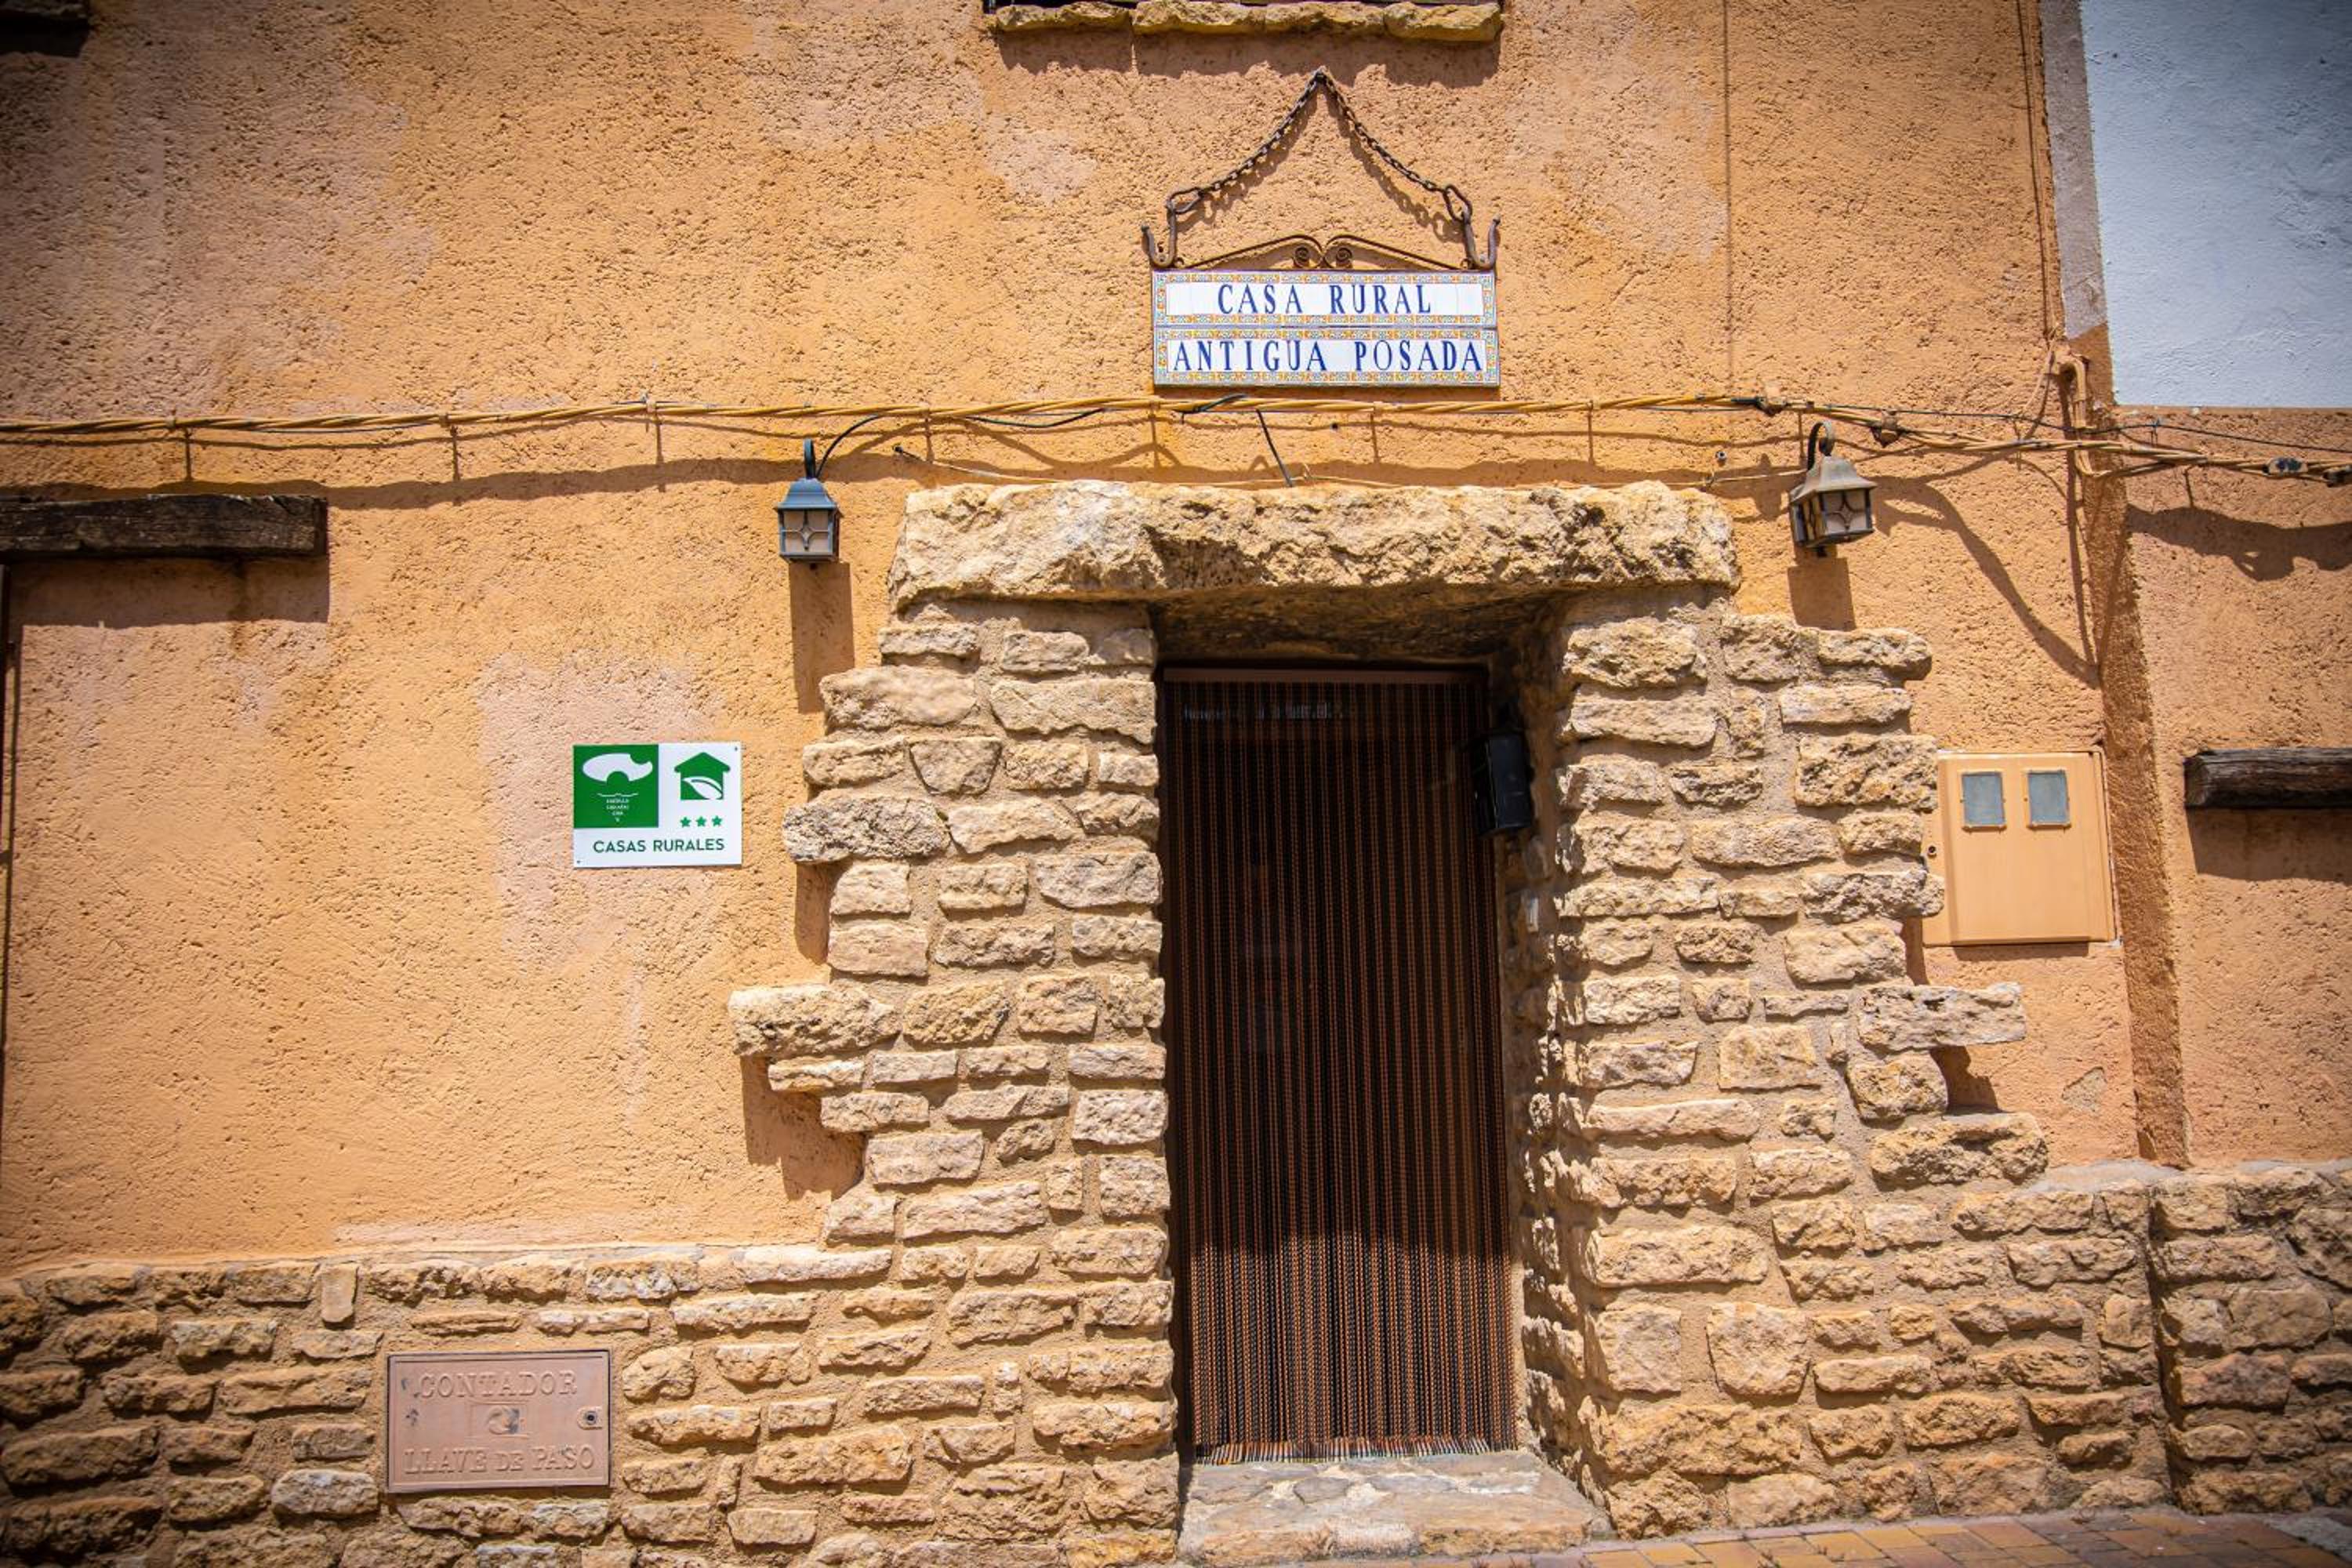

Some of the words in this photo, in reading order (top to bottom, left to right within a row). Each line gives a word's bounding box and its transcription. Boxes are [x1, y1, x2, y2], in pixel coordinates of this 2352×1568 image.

[1218, 284, 1303, 314] CASA
[1330, 285, 1432, 314] RURAL
[1174, 339, 1327, 372] ANTIGUA
[1356, 339, 1482, 372] POSADA
[593, 840, 646, 853] CASAS
[653, 839, 724, 852] RURALES
[419, 1370, 577, 1399] CONTADOR
[404, 1449, 488, 1474] LLAVE
[495, 1450, 524, 1471] DE
[532, 1445, 594, 1470] PASO
